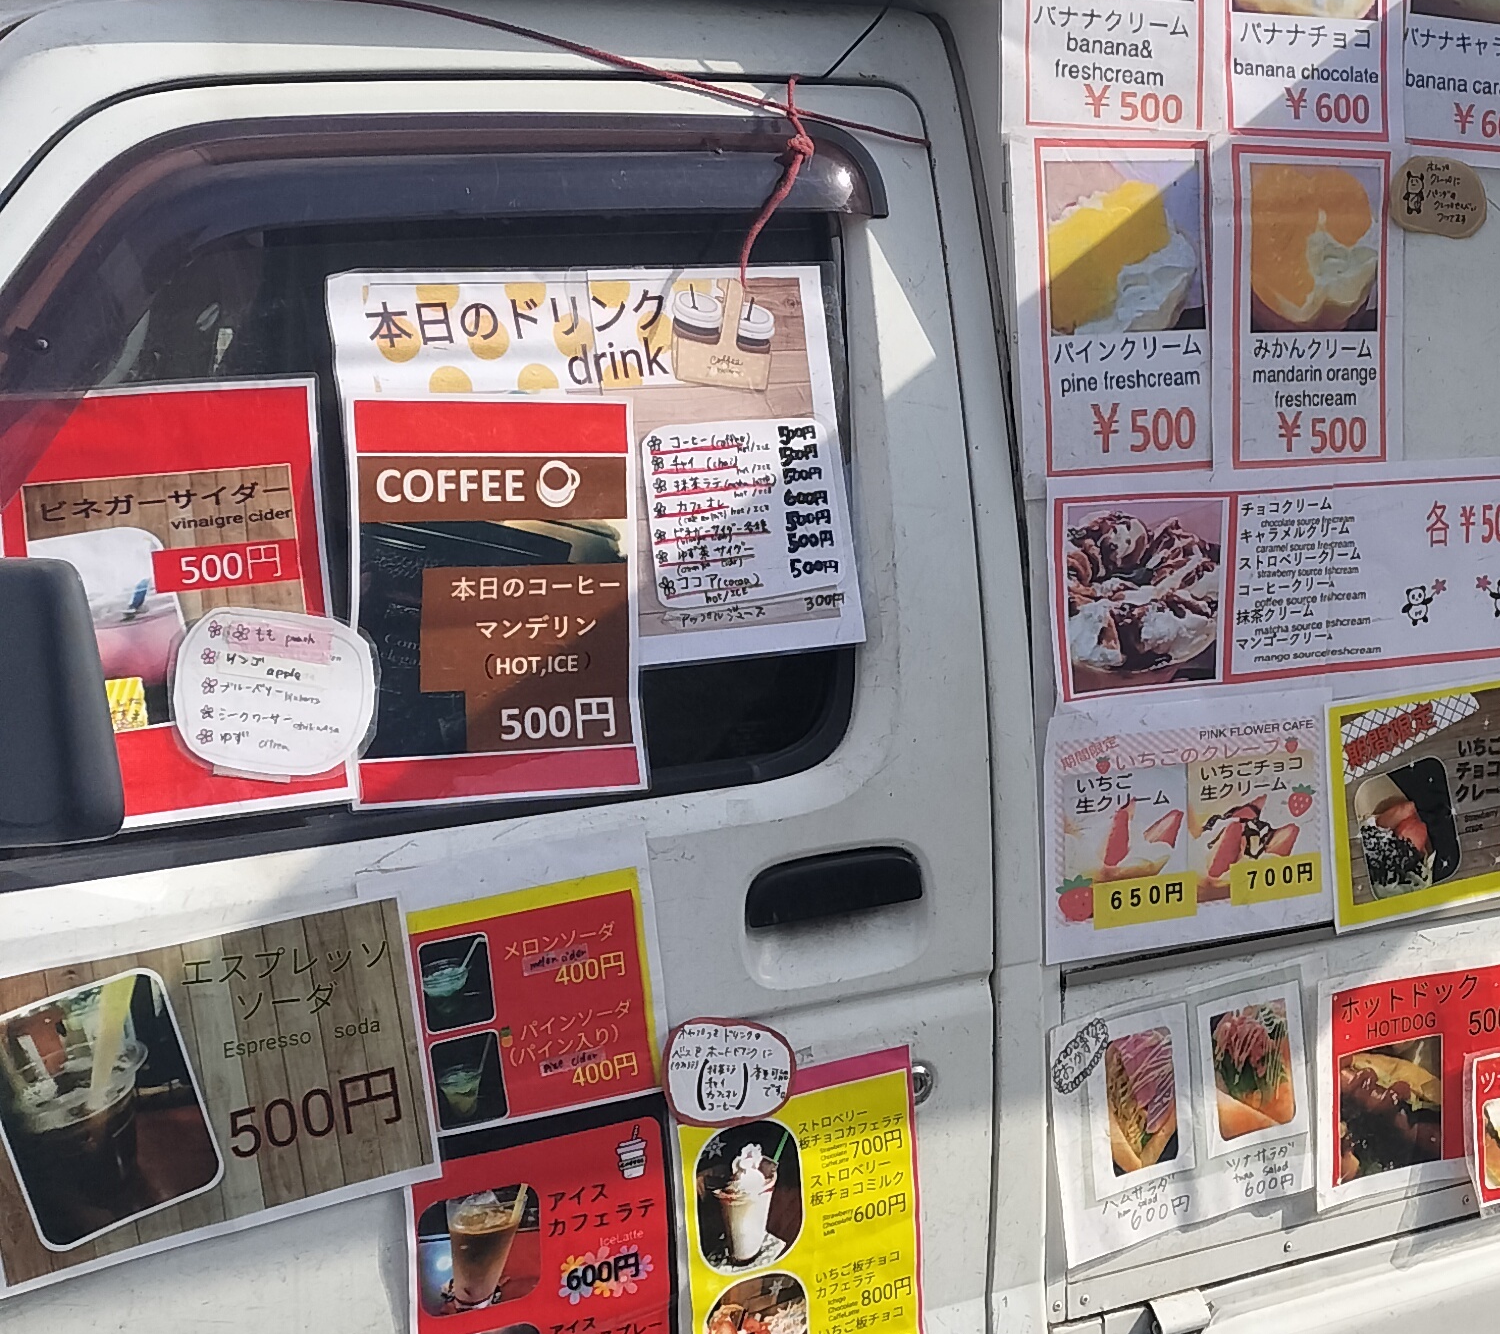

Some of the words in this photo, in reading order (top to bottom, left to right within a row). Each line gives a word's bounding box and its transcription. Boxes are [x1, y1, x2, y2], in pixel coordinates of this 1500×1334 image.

[1034, 3, 1190, 39] バナナクリーム
[1240, 21, 1372, 50] バナナチョコ
[1066, 33, 1153, 59] banana&
[1055, 59, 1164, 88] freshcream
[1233, 58, 1296, 81] banana
[1300, 62, 1379, 85] chocolate
[1405, 70, 1468, 94] banana
[365, 289, 670, 348] 本日のドリンク
[567, 337, 669, 386] drink
[1054, 336, 1202, 365] パインクリーム
[1253, 337, 1373, 361] みかんクリーム
[1060, 371, 1098, 398] pine
[1103, 366, 1201, 391] freshcream
[1252, 364, 1323, 384] mandarin
[1326, 367, 1377, 386] orange
[1274, 389, 1357, 409] freshcream
[376, 468, 525, 503] COFFEE
[40, 480, 290, 524] ビネガーサイダー
[1240, 497, 1332, 517] チョコクリーム
[171, 511, 244, 532] vinaigre
[248, 506, 292, 524] cider
[1240, 520, 1350, 544] キャラメルクリーム
[1426, 501, 1450, 548] 各
[788, 530, 834, 554] 500円
[181, 543, 282, 585] 500円
[790, 558, 839, 578] 500円
[451, 577, 620, 603] 本日のコーヒー
[804, 593, 845, 611] 300円
[475, 617, 598, 640] マンデリン
[1236, 603, 1314, 625] 抹茶クリーム
[266, 667, 301, 681] apple
[500, 696, 616, 741] 500円
[1199, 728, 1227, 741] PINK
[1230, 723, 1280, 737] FLOWER
[1282, 719, 1314, 731] CAFE
[1344, 701, 1437, 771] 期間限定
[1061, 735, 1119, 771] 期間限定
[1116, 737, 1281, 771] いちごのクレープ
[1076, 773, 1133, 793] いちご
[1200, 757, 1303, 780] いちごチョコ
[1076, 790, 1170, 814] 生クリーム
[1200, 778, 1287, 801] 生クリーム
[1247, 862, 1313, 889] 700円
[1110, 881, 1184, 910] 650円
[504, 921, 615, 961] メロンソーダ
[181, 939, 388, 987] エスプレッソ
[554, 951, 626, 985] 400円
[238, 981, 338, 1021] ソーダ
[1340, 972, 1480, 1024] ホットドック
[520, 999, 631, 1041] パインソーダ
[1366, 1012, 1437, 1040] HOTDOG
[223, 1027, 312, 1059] Espresso
[334, 1017, 381, 1040] soda
[509, 1024, 619, 1067] (パイン入り)
[572, 1051, 638, 1087] 400円
[230, 1067, 402, 1159] 500円
[799, 1110, 867, 1134] ストロベリー
[799, 1113, 903, 1150] 板チョコカフェラテ
[849, 1129, 902, 1159] 700円
[1226, 1141, 1295, 1171] ツナサラダ
[810, 1171, 903, 1206] 板チョコミルク
[811, 1160, 891, 1188] ストロベリー
[1244, 1173, 1294, 1197] 600円
[548, 1183, 608, 1212] アイス
[854, 1192, 906, 1223] 600円
[548, 1198, 655, 1237] カフェラテ
[1130, 1194, 1190, 1231] 600円
[600, 1229, 644, 1247] IceLatte
[566, 1252, 640, 1291] 600円
[816, 1250, 900, 1283] いちご板チョコ
[816, 1271, 875, 1299] カフェラテ
[861, 1276, 911, 1307] 800円
